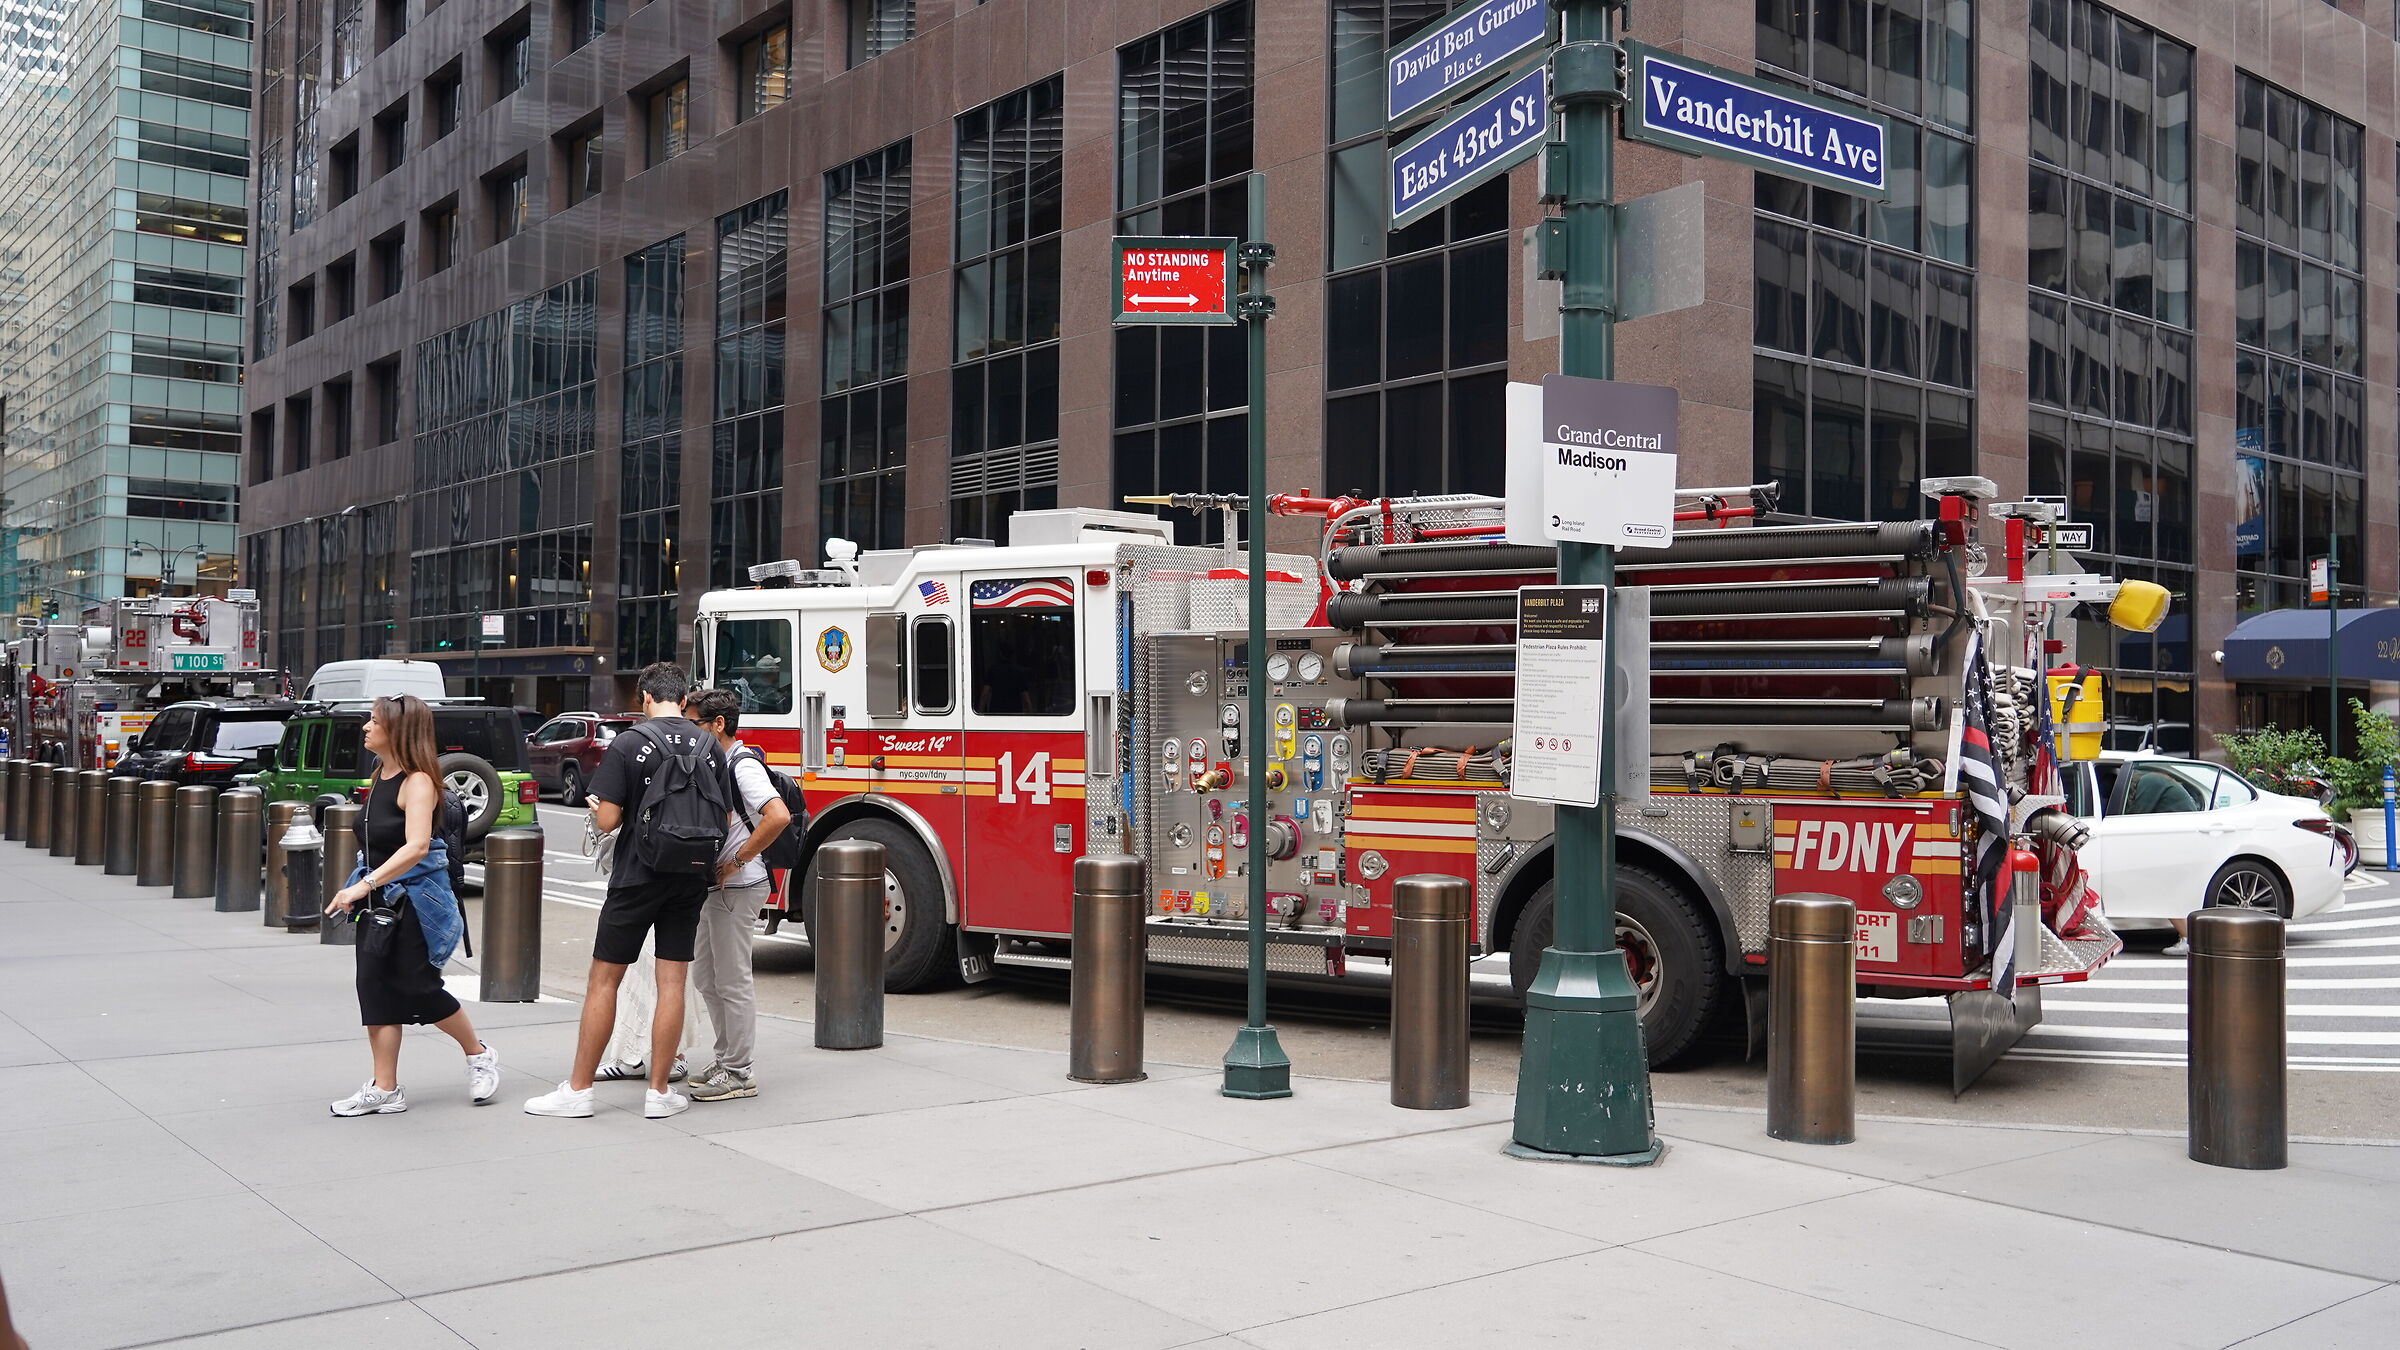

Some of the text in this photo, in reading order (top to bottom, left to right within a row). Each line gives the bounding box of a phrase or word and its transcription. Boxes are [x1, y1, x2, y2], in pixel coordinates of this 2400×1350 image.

[1396, 39, 1440, 86] David
[1443, 26, 1474, 59] Ben
[1443, 52, 1482, 85] Place
[1650, 75, 1878, 173] Vanderbilt Ave
[1401, 94, 1536, 202] East 43rd St
[1127, 253, 1209, 267] NO STANDING
[1127, 268, 1180, 284] Anytime
[1557, 424, 1662, 450] Grand Central
[1558, 448, 1626, 471] Madison
[2061, 532, 2084, 542] WAY
[1524, 598, 1564, 606] VANDERBILT PLAZA
[125, 629, 147, 648] 22
[243, 631, 257, 649] 22
[2377, 640, 2388, 658] 22
[175, 655, 223, 668] W 100 St
[878, 734, 953, 752] "Sweet 14"
[899, 769, 948, 781] nyc.gov/fdny
[997, 751, 1051, 805] 14
[1793, 820, 1914, 874] FDNY
